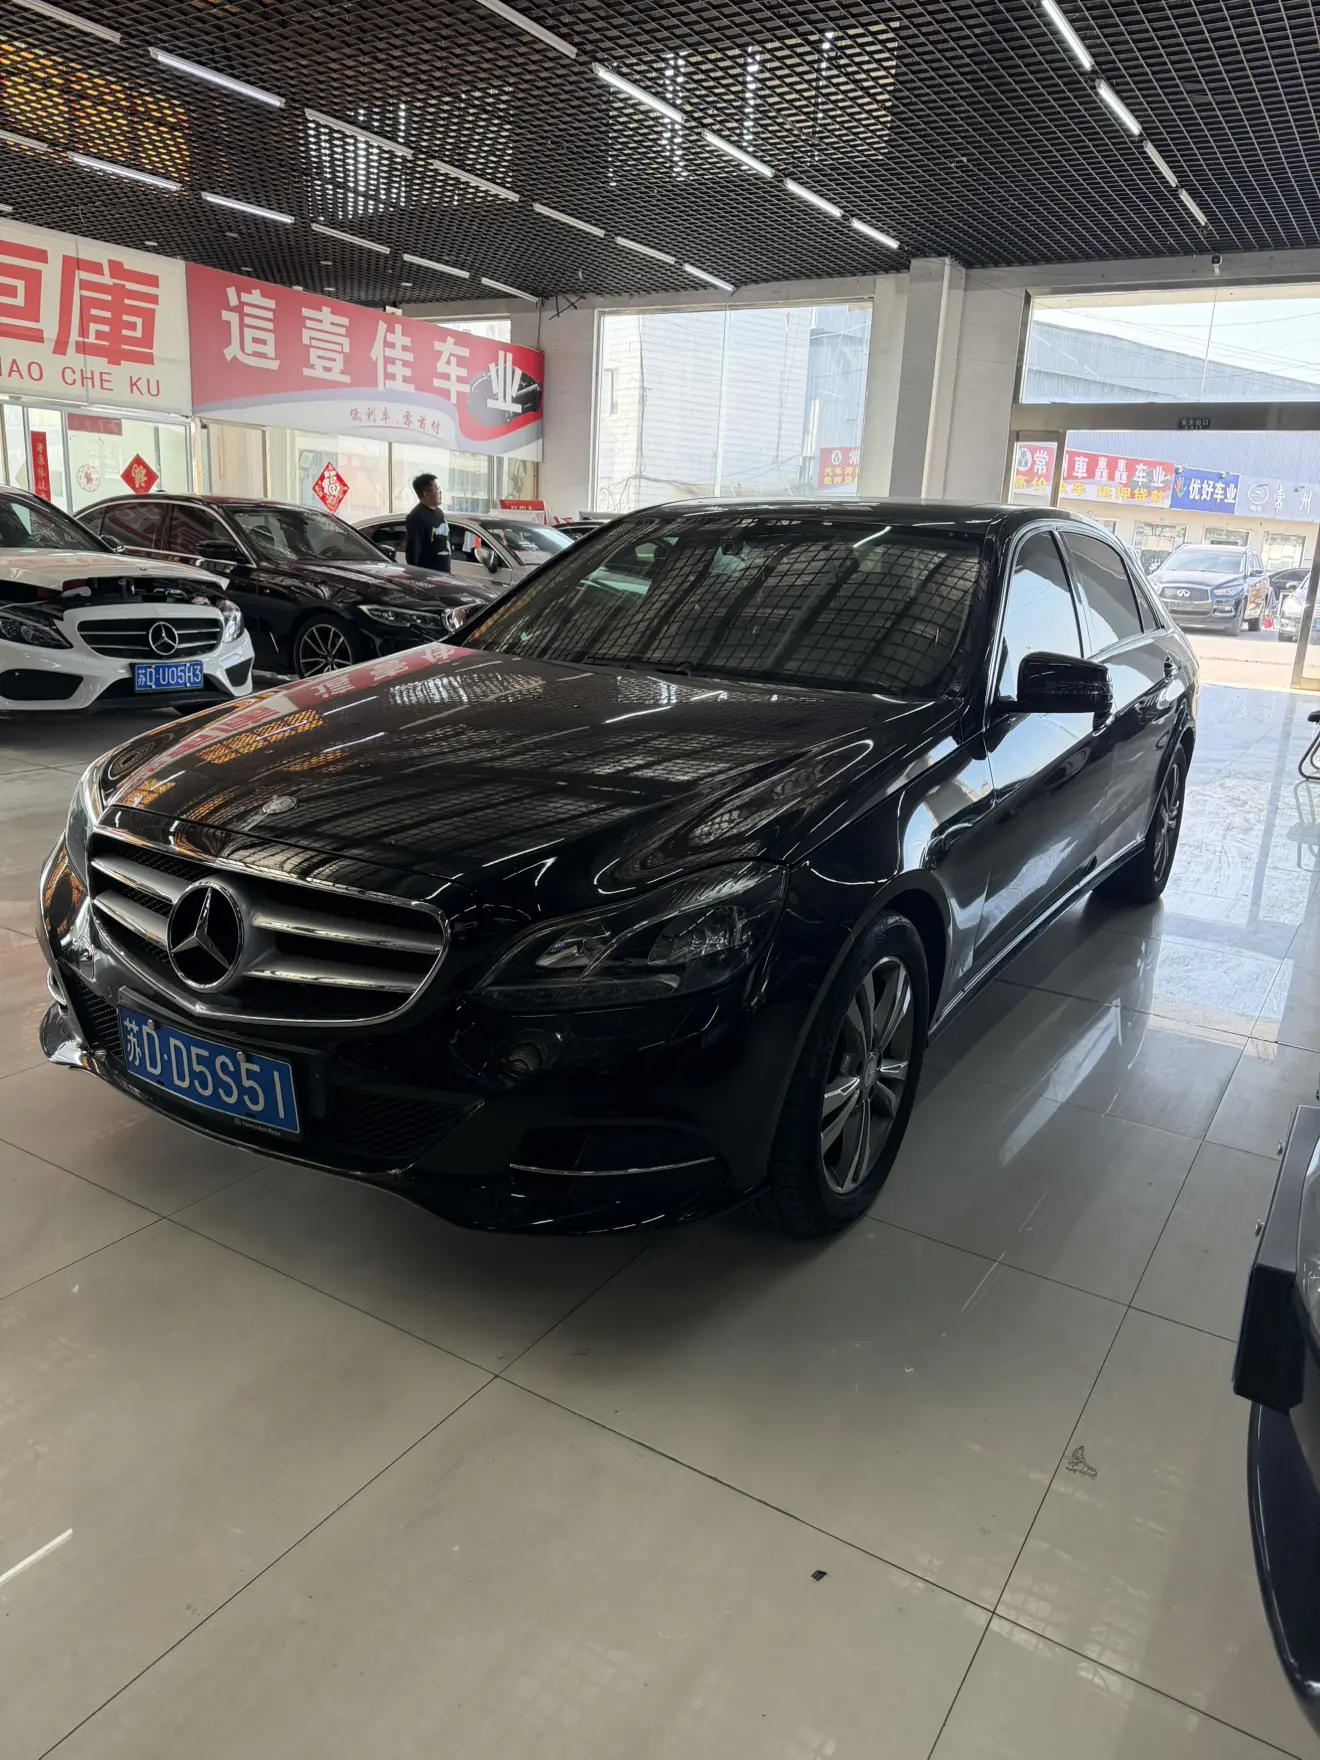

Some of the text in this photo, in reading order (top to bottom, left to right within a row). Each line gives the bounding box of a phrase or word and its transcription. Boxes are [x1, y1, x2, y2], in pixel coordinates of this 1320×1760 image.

[0, 356, 161, 398] AO CHE KU
[1189, 478, 1238, 503] 优好车业
